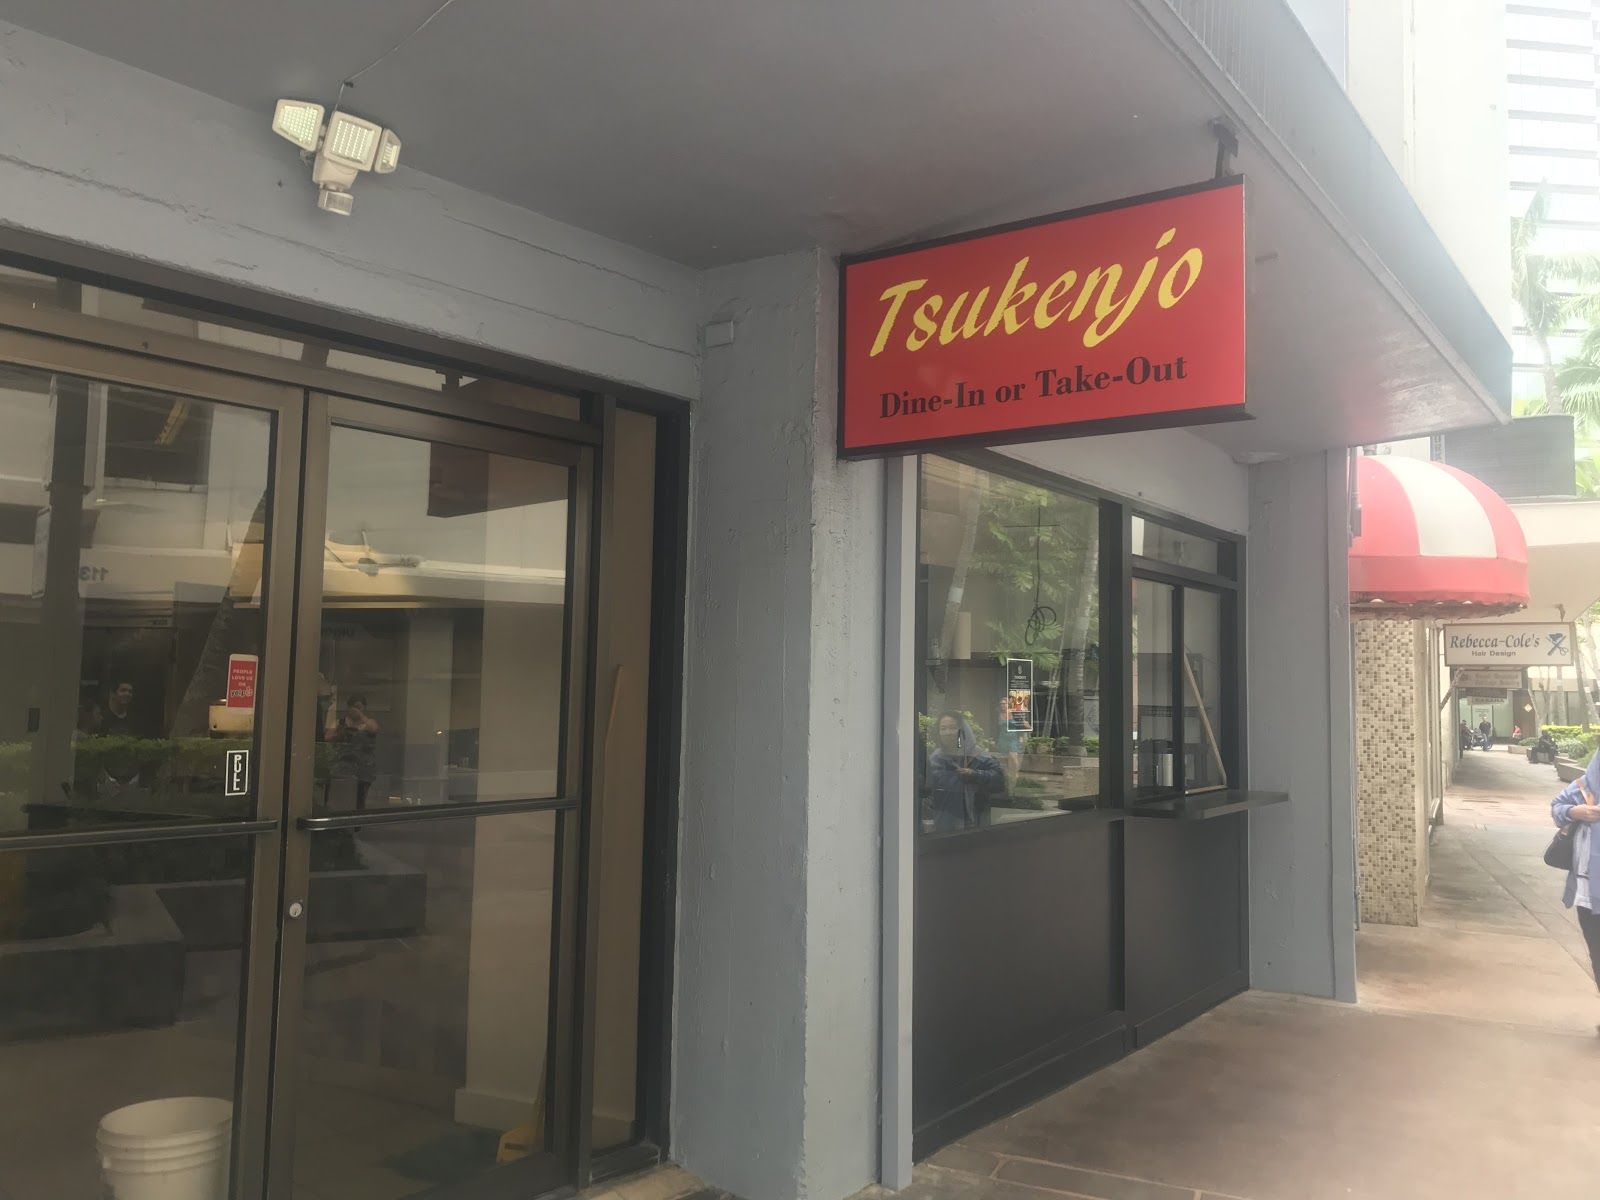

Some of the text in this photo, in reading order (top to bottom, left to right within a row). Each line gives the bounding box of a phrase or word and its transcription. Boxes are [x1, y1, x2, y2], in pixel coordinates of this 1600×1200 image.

[869, 227, 1203, 357] Tsukenjo
[879, 355, 1188, 419] Dine-In or Take-Out
[1450, 633, 1540, 649] Rebecca-Cole's
